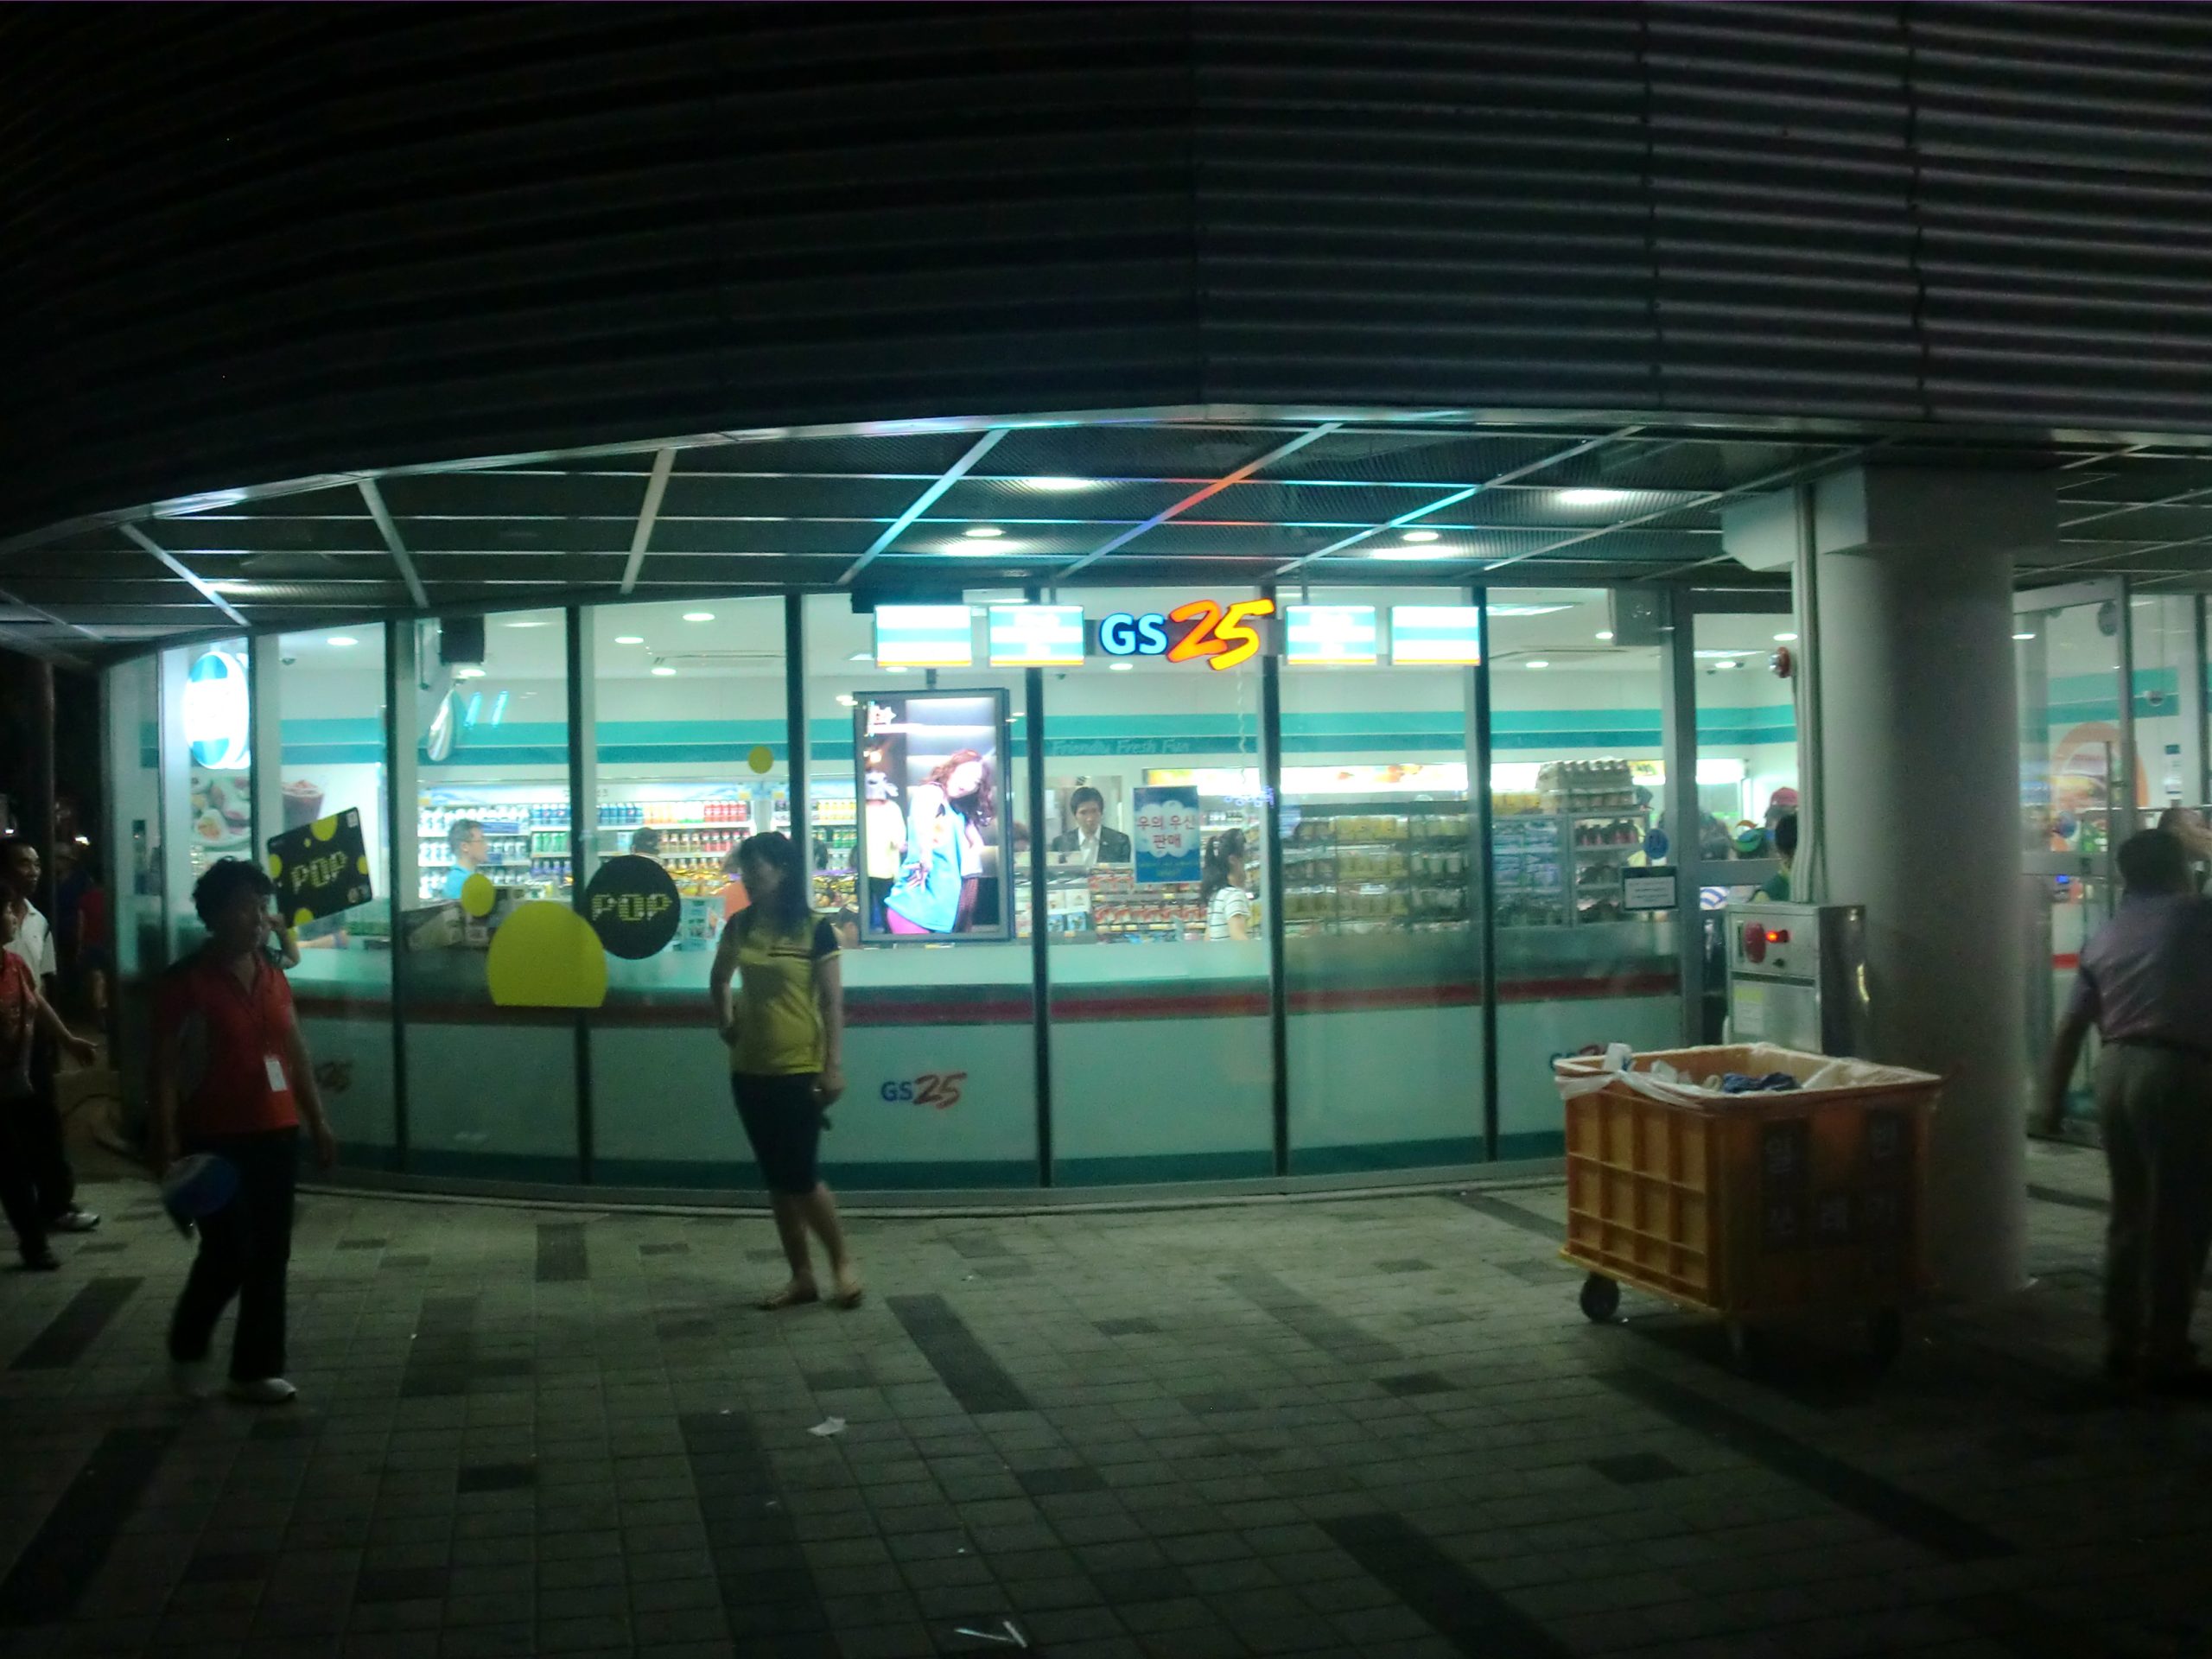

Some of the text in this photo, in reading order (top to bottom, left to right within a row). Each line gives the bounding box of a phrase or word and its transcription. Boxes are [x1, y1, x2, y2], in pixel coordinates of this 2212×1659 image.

[1100, 598, 1275, 671] GS25
[1052, 740, 1109, 755] Friendly
[1116, 739, 1156, 754] Fresh
[1136, 816, 1164, 830] 우의
[1153, 834, 1181, 849] 판매
[290, 851, 347, 893] POP
[591, 893, 673, 921] POP
[880, 1071, 967, 1109] GS25
